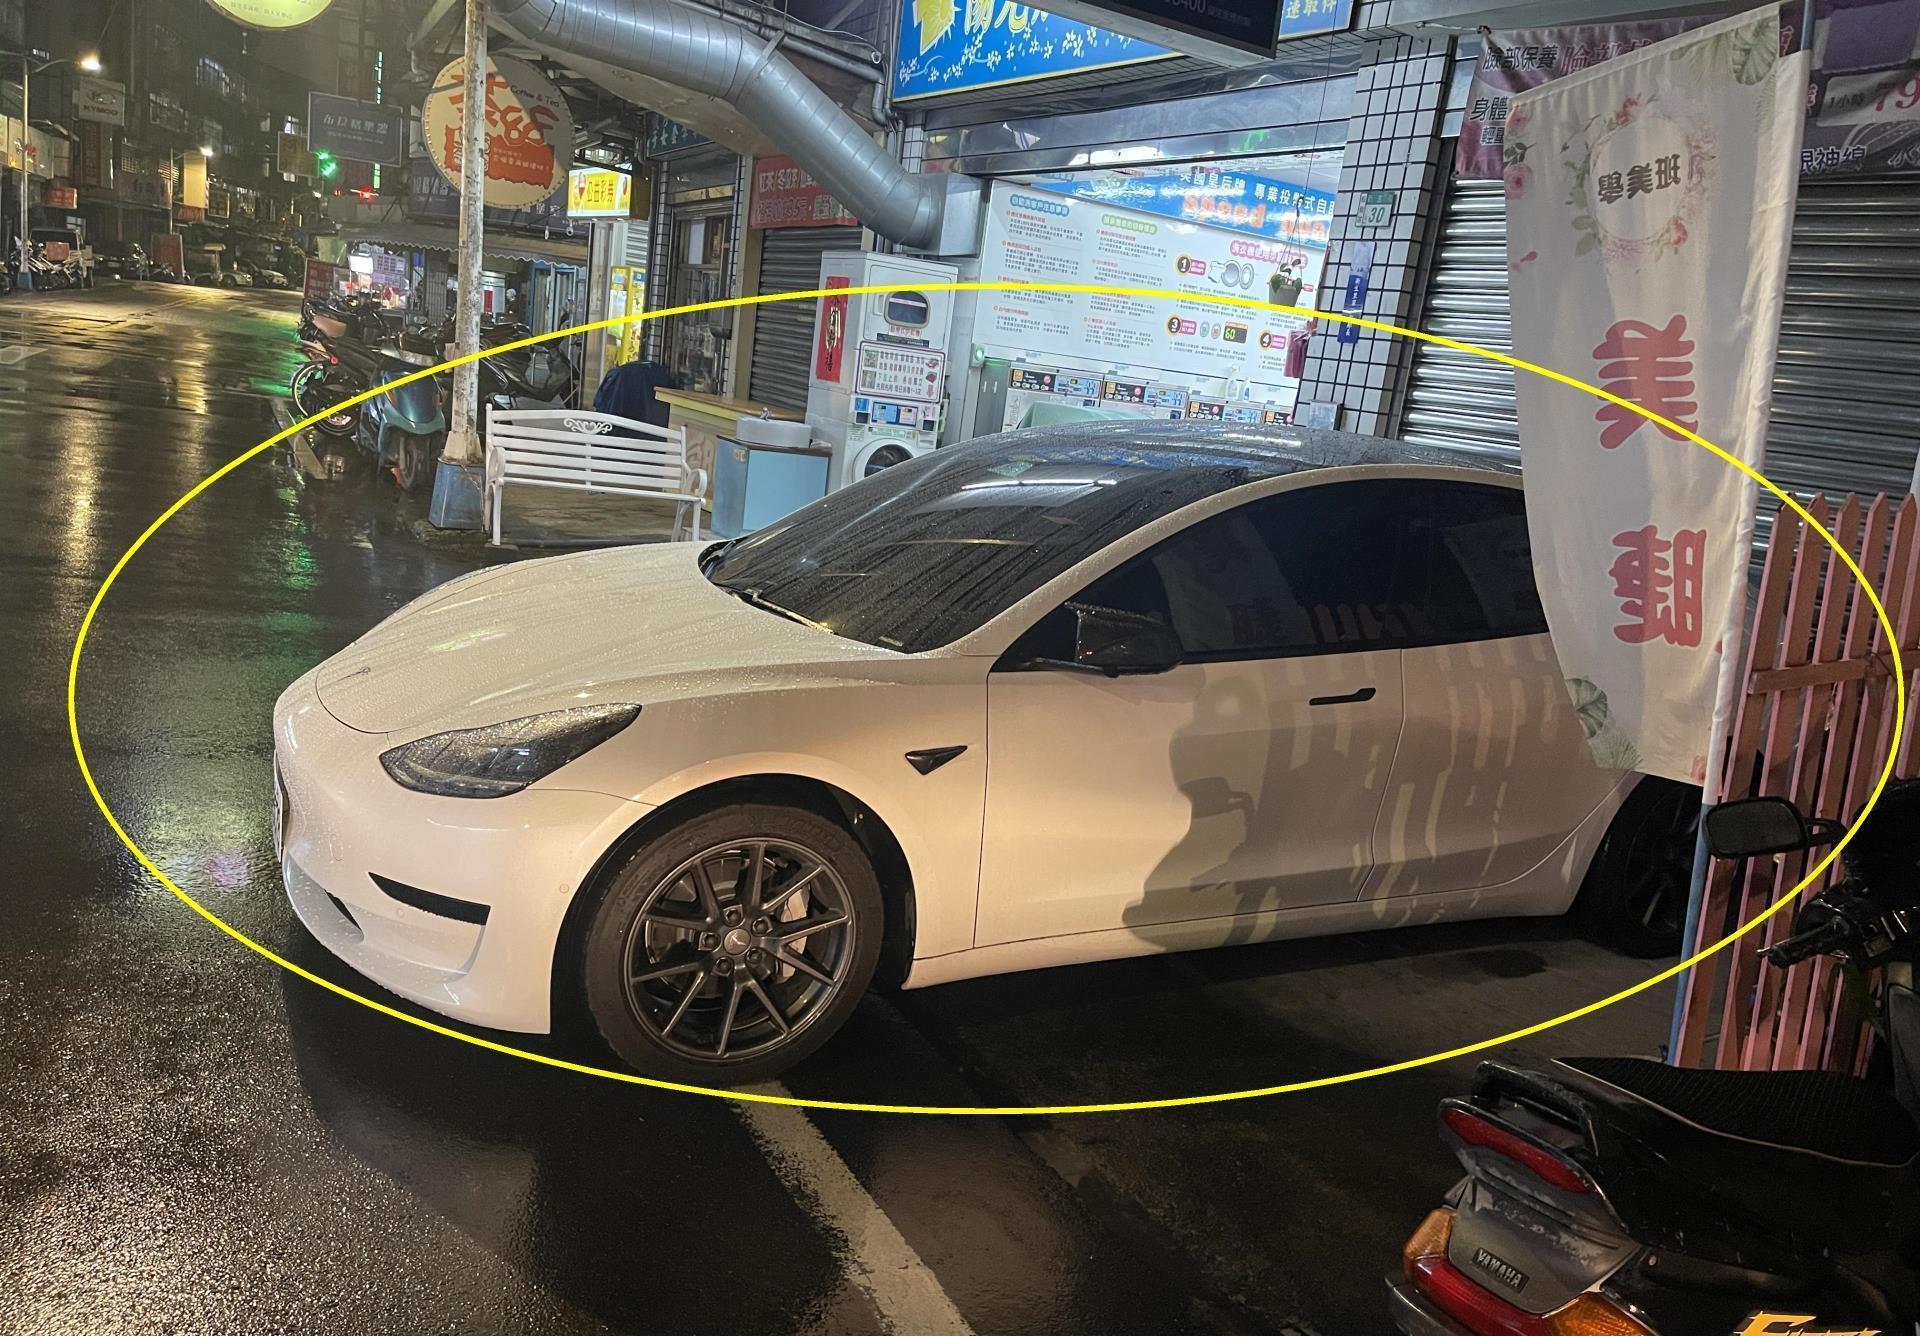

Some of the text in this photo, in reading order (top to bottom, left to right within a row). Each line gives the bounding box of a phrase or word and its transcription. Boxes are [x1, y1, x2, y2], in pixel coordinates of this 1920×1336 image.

[1482, 45, 1558, 71] 臉部保養
[1470, 97, 1508, 121] 身體
[1367, 206, 1386, 224] 30
[1476, 1249, 1522, 1287] YAMAHA
